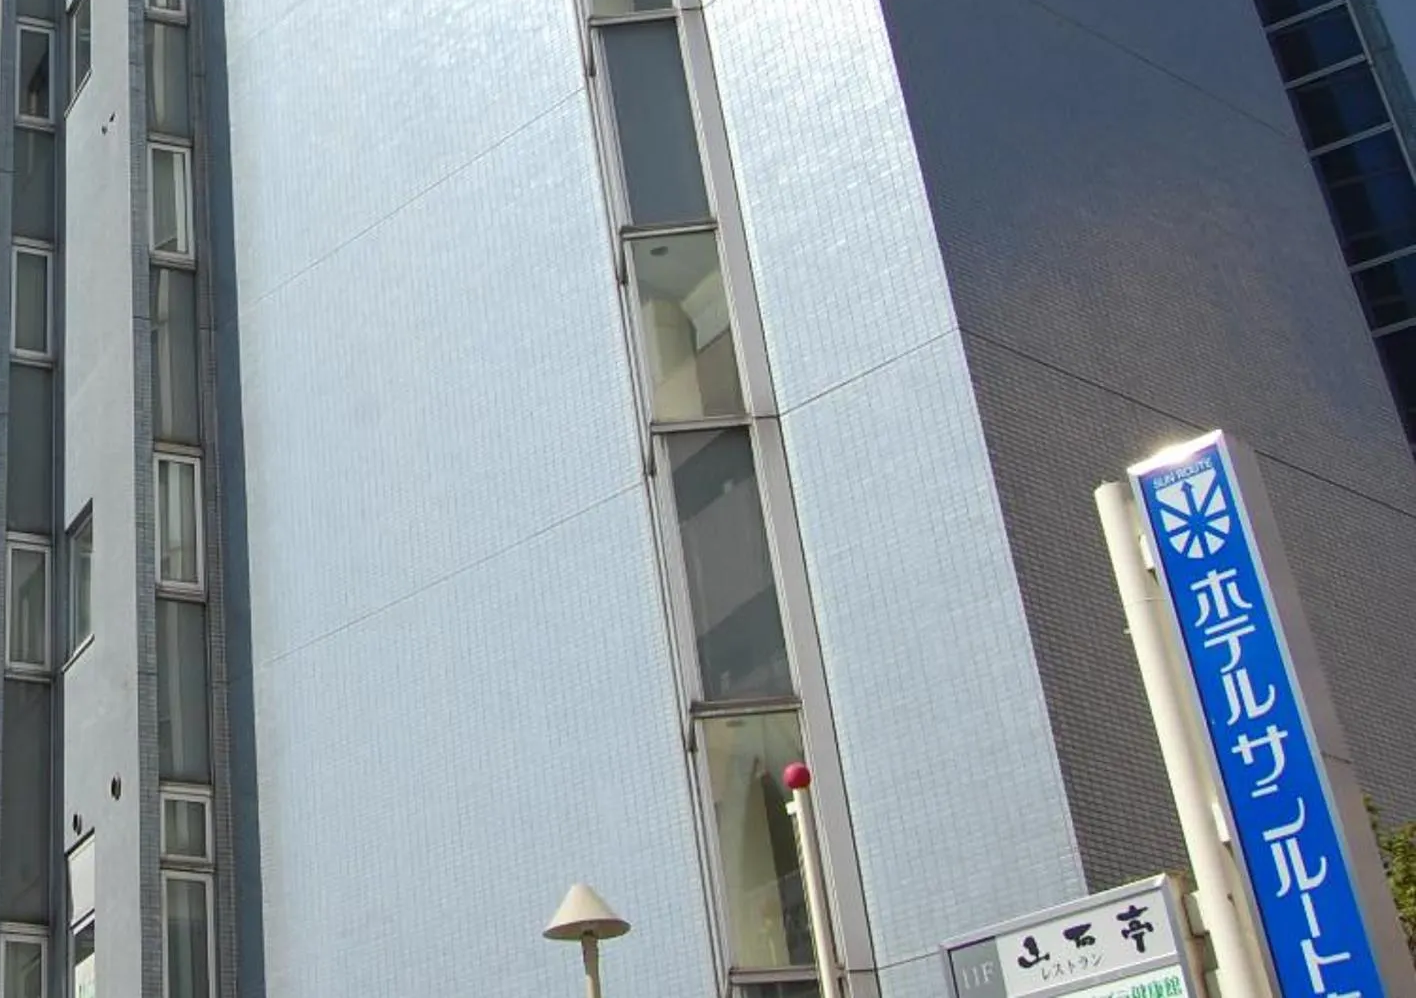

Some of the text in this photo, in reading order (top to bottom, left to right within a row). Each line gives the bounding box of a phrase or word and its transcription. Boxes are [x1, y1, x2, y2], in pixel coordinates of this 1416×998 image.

[1190, 568, 1361, 998] ホテルサンルート
[1041, 954, 1102, 980] レストラン
